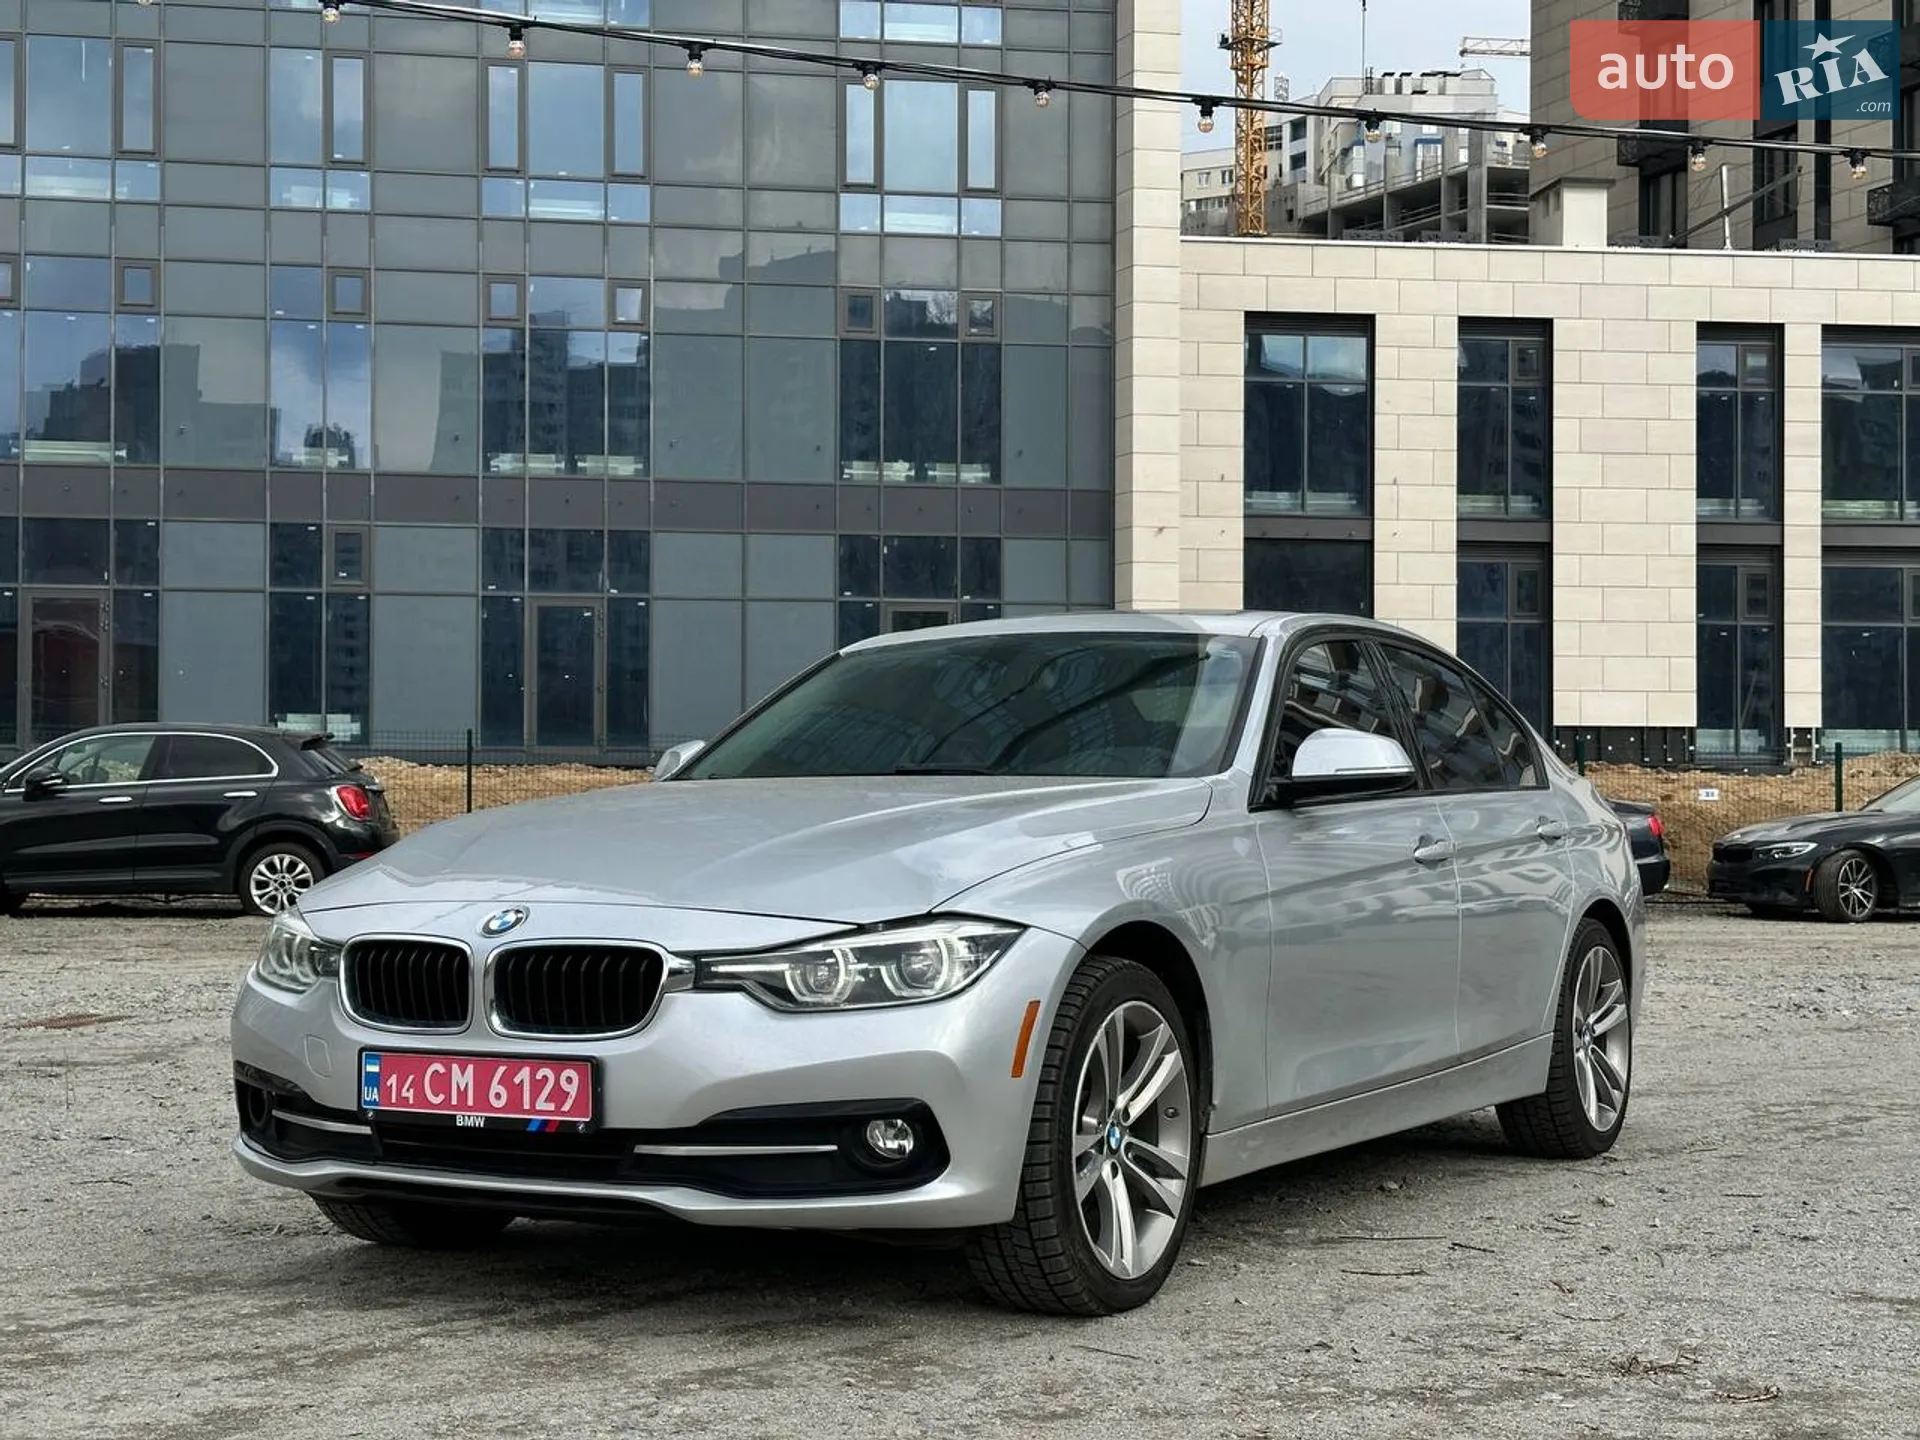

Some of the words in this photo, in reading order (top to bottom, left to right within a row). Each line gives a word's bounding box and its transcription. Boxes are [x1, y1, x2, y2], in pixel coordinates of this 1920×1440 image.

[364, 1086, 379, 1102] UA
[386, 1073, 415, 1104] 14
[424, 1062, 474, 1107] CM
[488, 1064, 580, 1112] 6129
[456, 1115, 485, 1128] BMW
